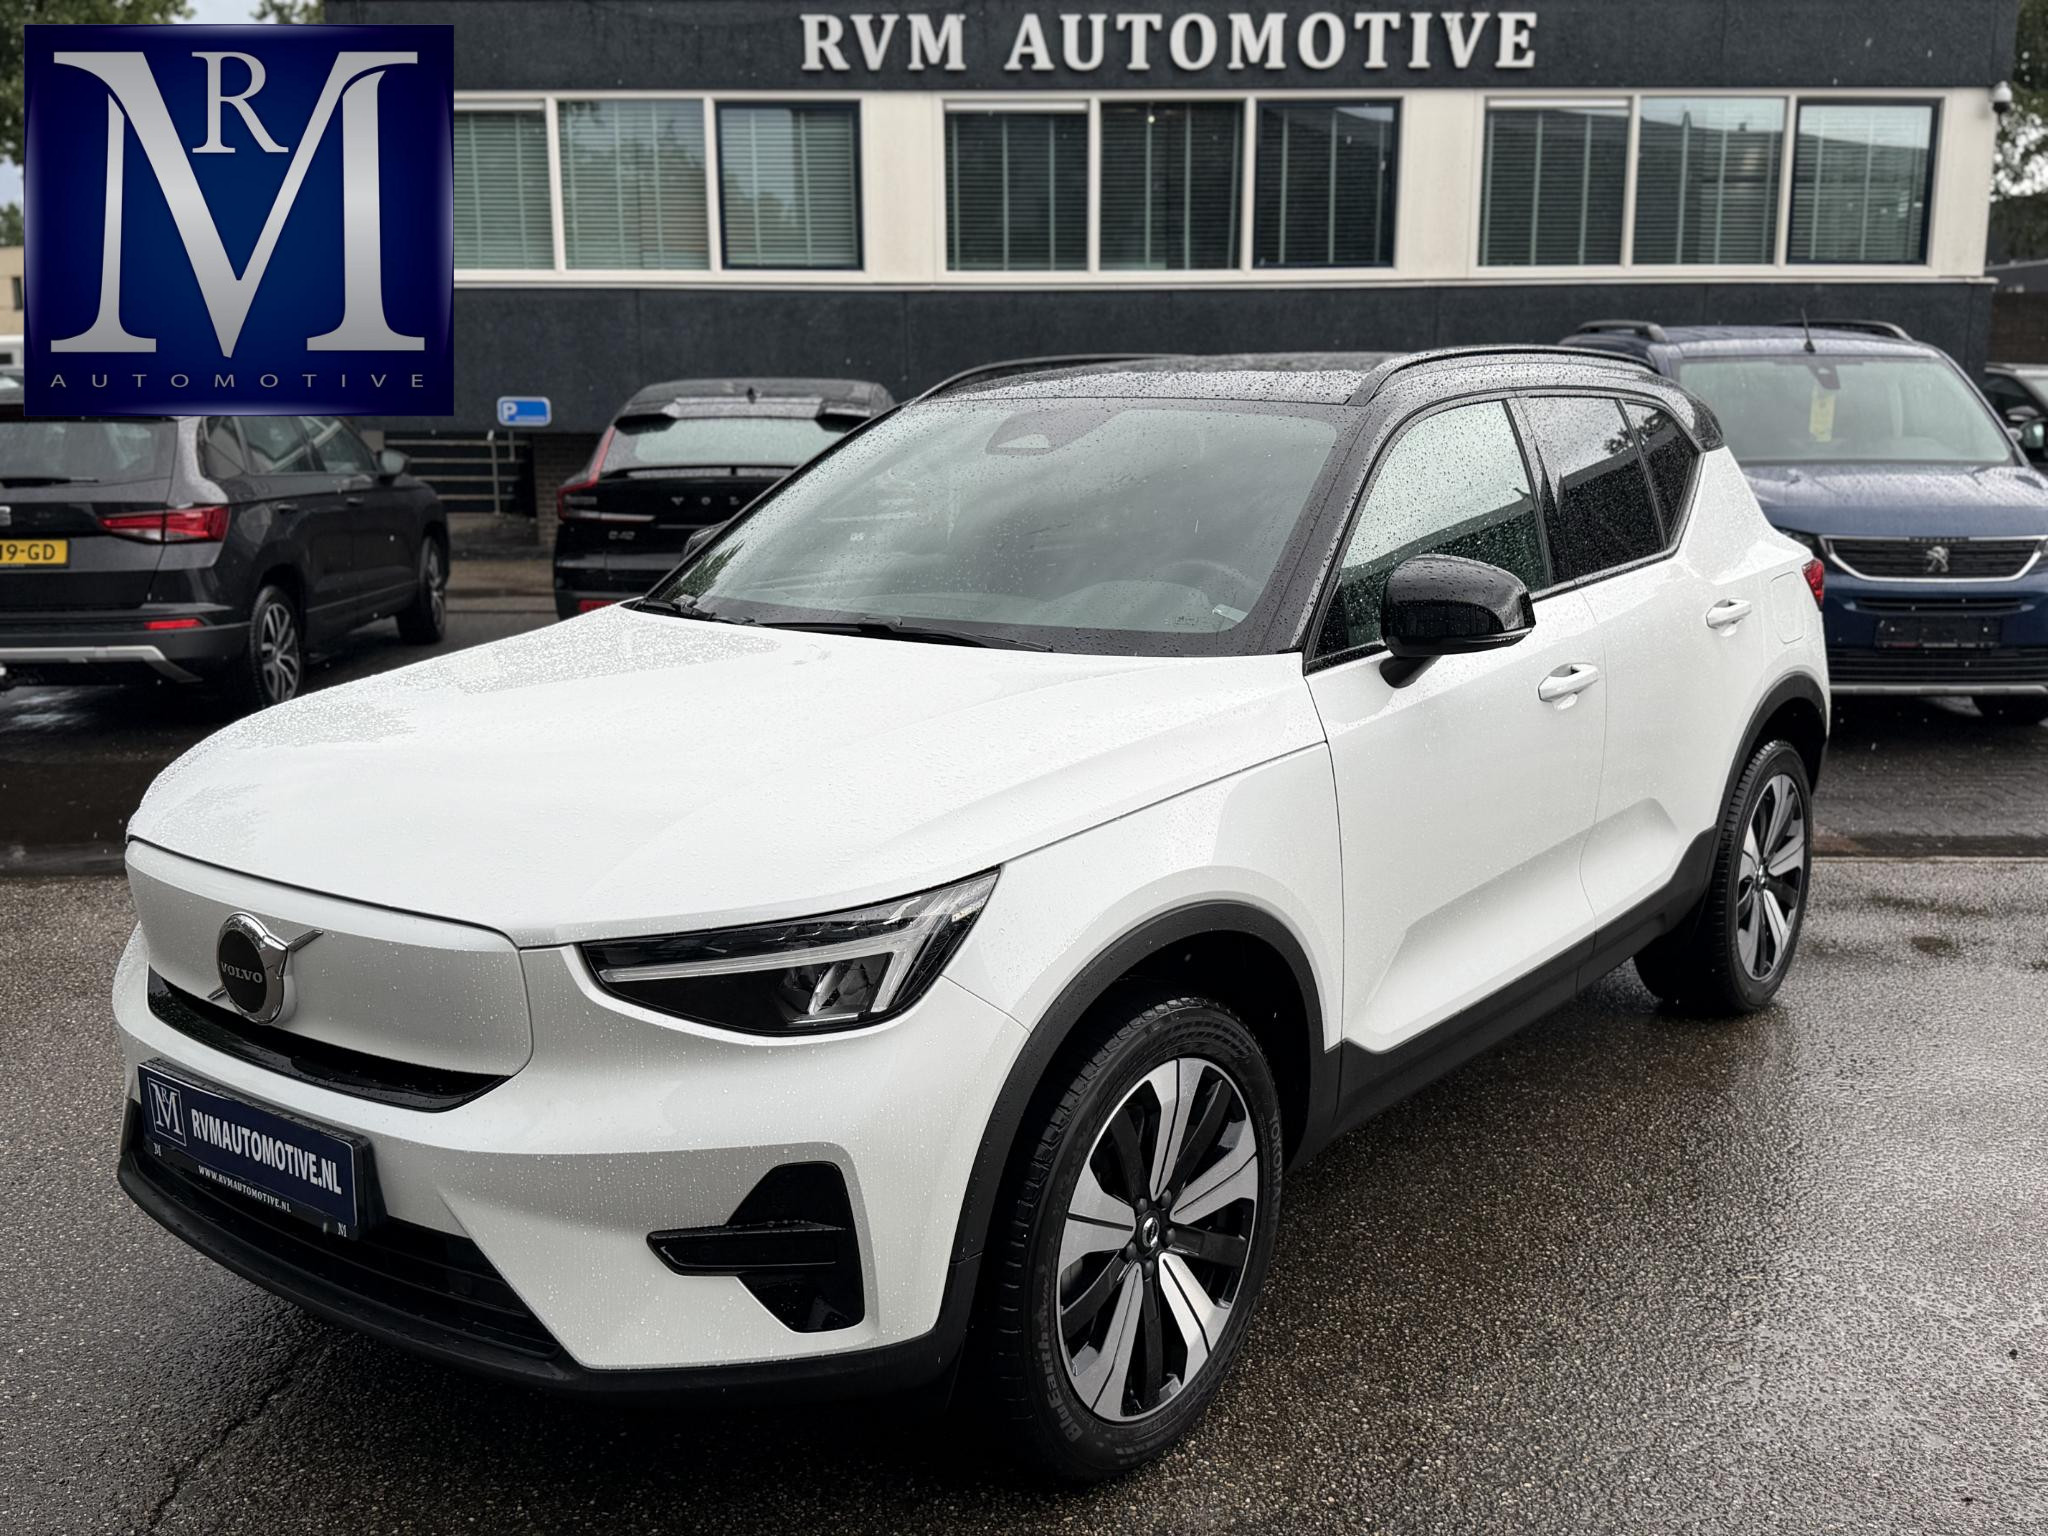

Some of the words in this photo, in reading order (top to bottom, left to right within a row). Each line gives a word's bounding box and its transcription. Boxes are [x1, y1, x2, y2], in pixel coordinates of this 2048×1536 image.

[800, 13, 966, 71] RVM
[1004, 12, 1538, 71] AUTOMOTIVE
[502, 402, 518, 422] P
[671, 496, 740, 506] VOL
[221, 961, 263, 984] VOLVO
[191, 1108, 342, 1195] RVMAUTOMOTIVE.NL
[198, 1164, 292, 1213] WWW.RVMAUTOMOTIVE.NL
